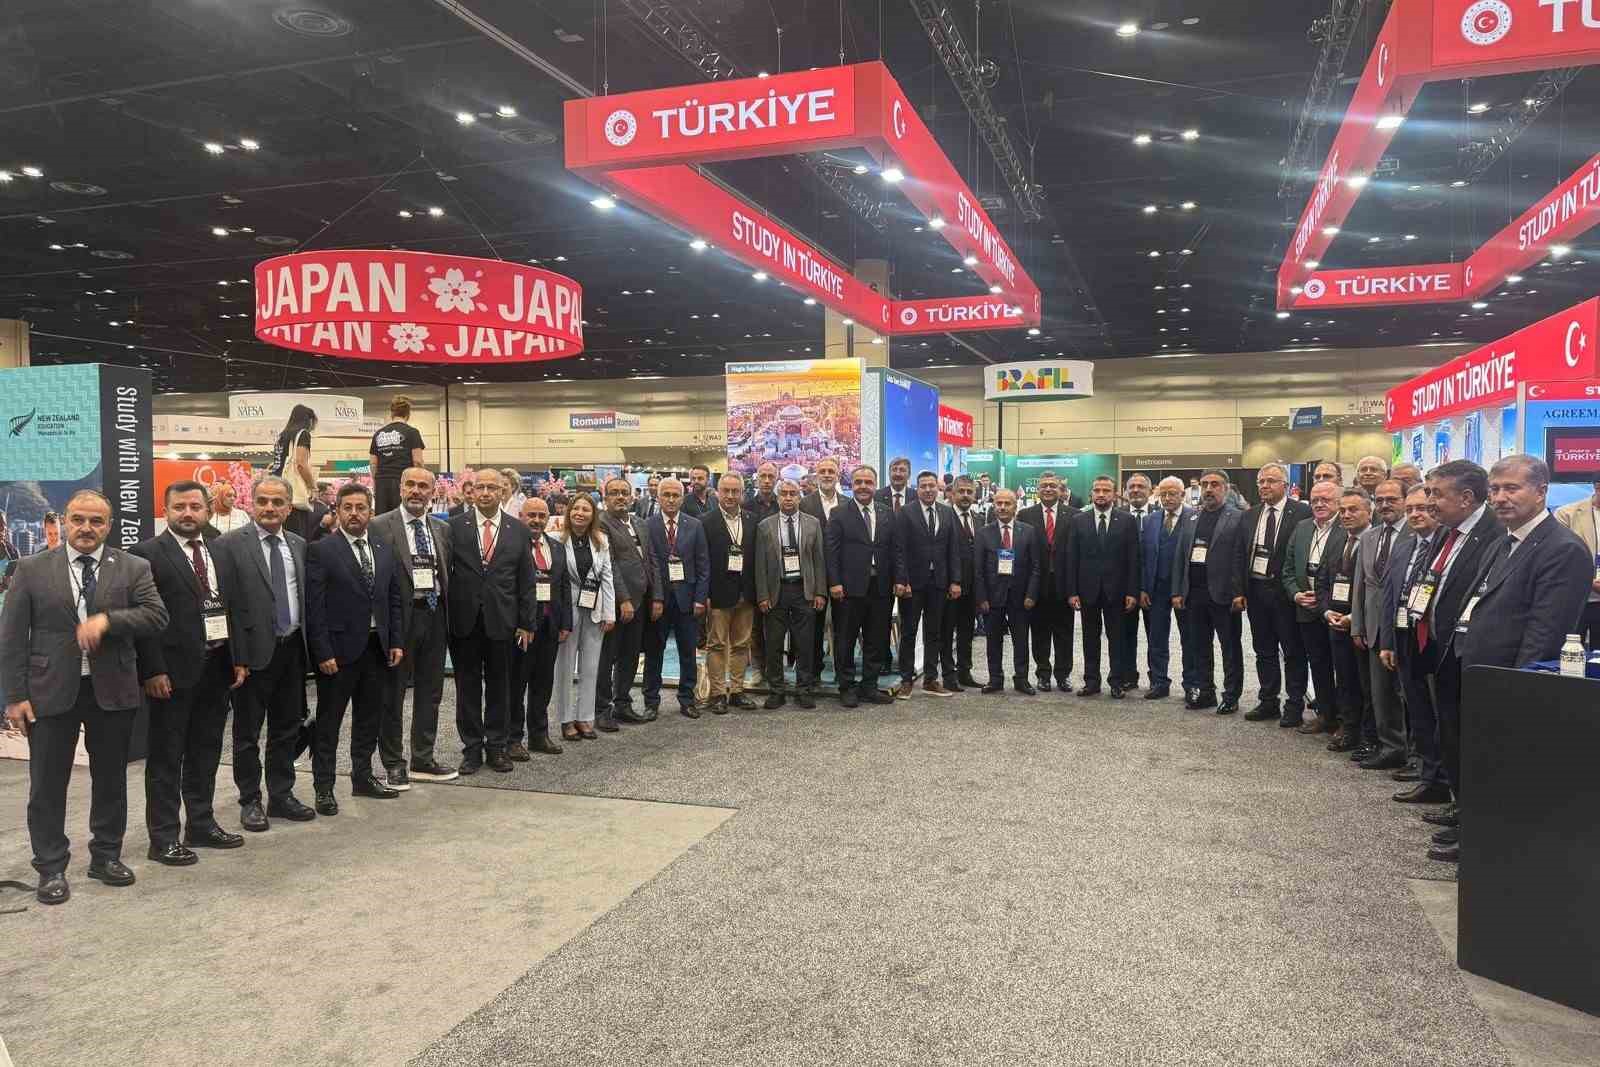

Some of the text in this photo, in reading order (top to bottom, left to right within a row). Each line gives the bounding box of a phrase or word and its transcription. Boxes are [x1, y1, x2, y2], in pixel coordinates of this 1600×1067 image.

[652, 88, 835, 139] TÜRKİYE
[958, 191, 1015, 288] STUDY IN TÜRKİYE
[1519, 198, 1560, 251] STUDY
[1561, 184, 1578, 222] IN
[732, 210, 844, 300] STUDY IN TÜRKİYE
[261, 262, 406, 320] JAPAN
[1335, 272, 1451, 296] TÜRKİYE
[925, 301, 1019, 322] TÜRKİYE
[996, 367, 1074, 391] BRASIL
[1412, 351, 1516, 417] STUDY IN TÜRKİYE
[572, 415, 640, 428] Romania Romania
[1136, 424, 1174, 433] Restrooms
[115, 386, 142, 554] Study with New Zea
[1136, 458, 1173, 466] Restrooms
